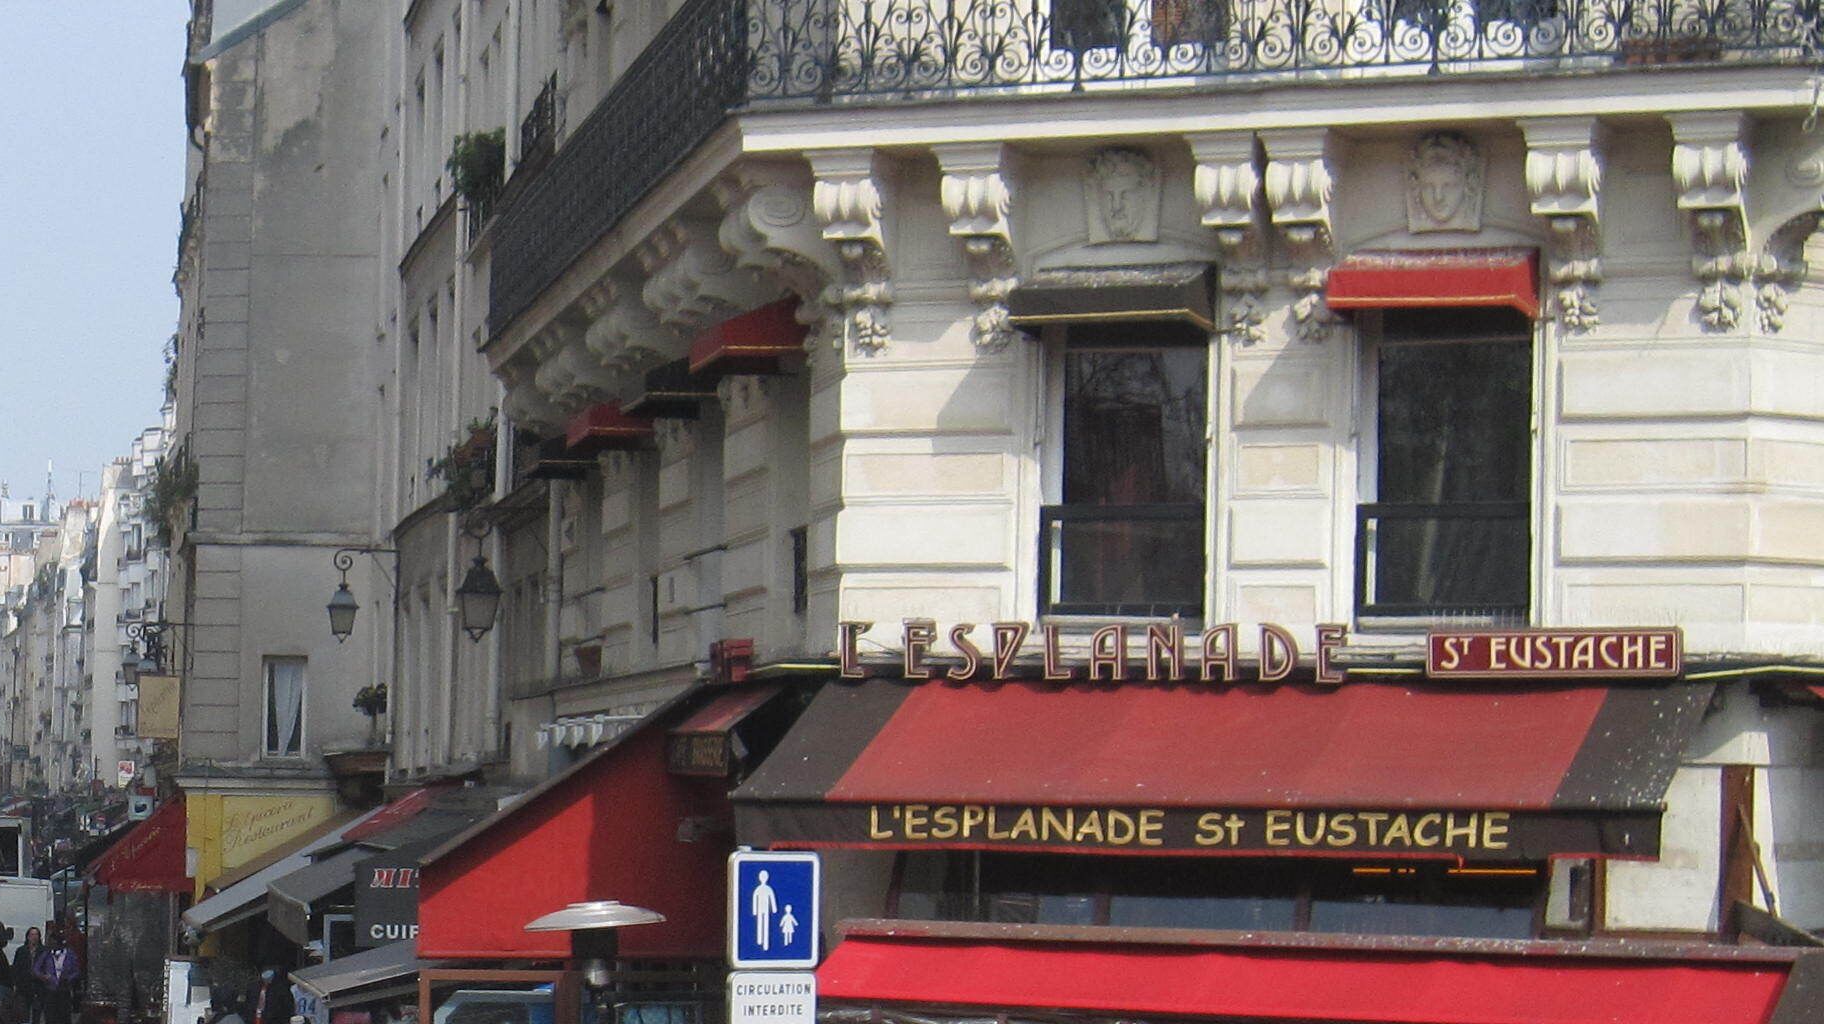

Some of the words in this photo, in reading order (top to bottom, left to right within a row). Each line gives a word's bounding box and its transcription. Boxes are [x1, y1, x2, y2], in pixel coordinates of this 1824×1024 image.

[839, 620, 1349, 683] L'ESPLANADE
[1490, 634, 1668, 671] EUSTACHE
[869, 804, 1166, 846] L'ESPLANADE
[1194, 812, 1246, 847] St
[1266, 809, 1511, 849] EUSTACHE
[370, 868, 419, 888] MI
[736, 984, 811, 996] CIRCULATION
[743, 1004, 804, 1017] INTERDITE
